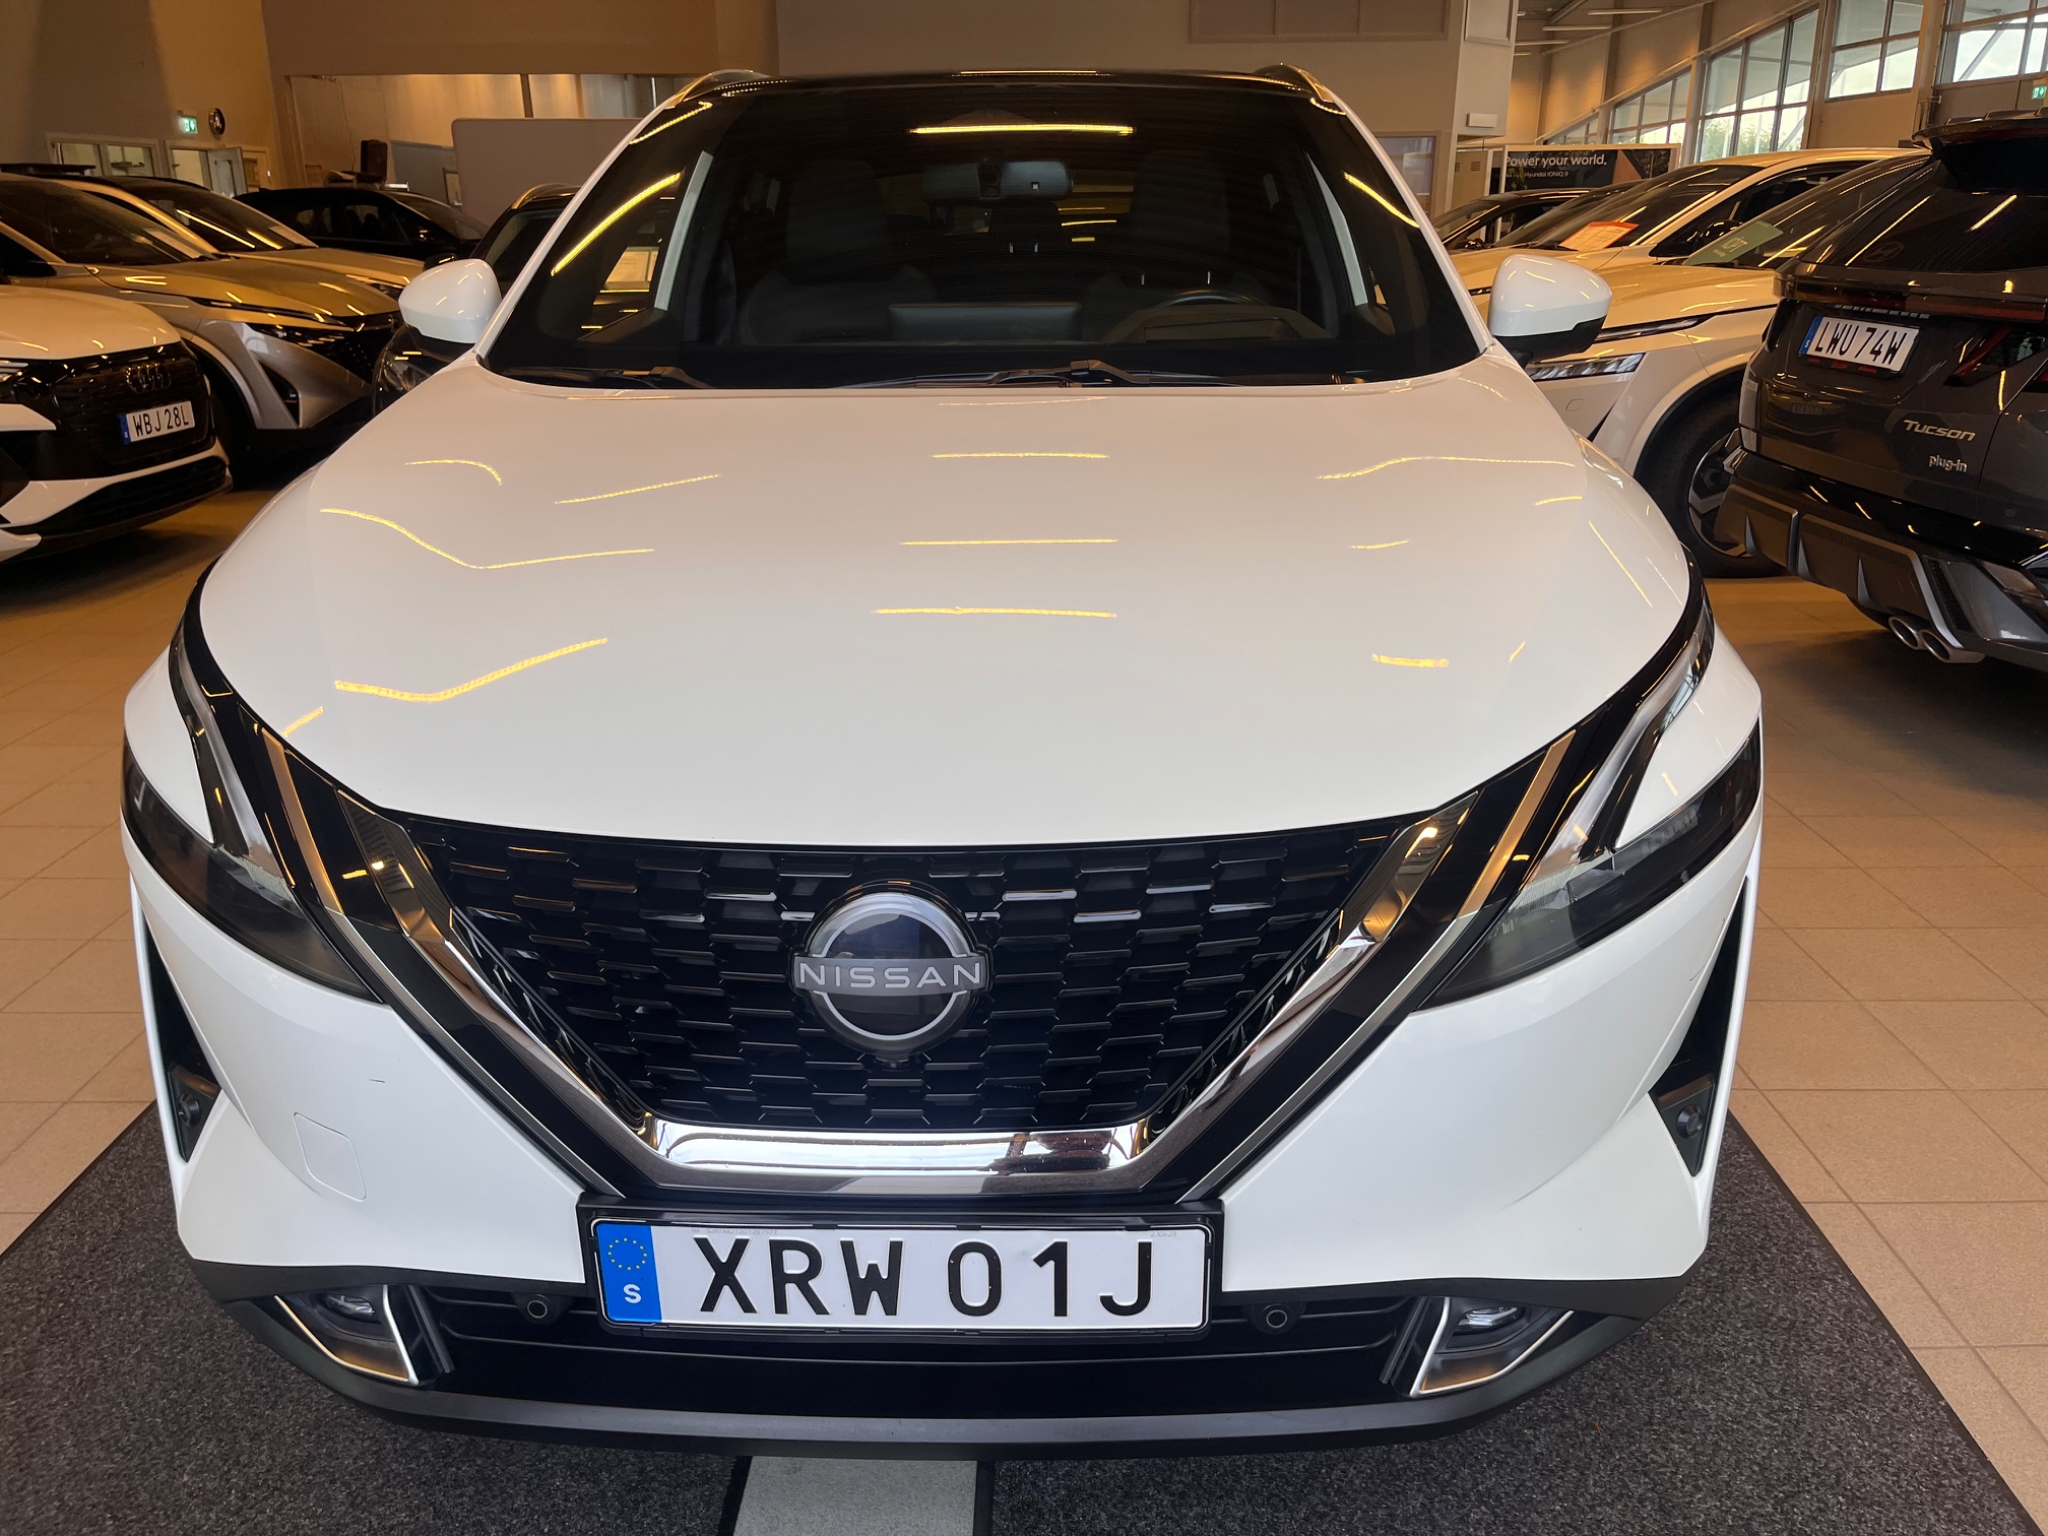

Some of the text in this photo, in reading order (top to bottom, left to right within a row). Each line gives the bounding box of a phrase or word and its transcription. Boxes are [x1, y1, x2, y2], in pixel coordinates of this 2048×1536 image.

[1542, 156, 1568, 168] your
[1571, 153, 1607, 166] world.
[1524, 171, 1546, 179] Hyundai
[1804, 340, 1810, 348] S
[1815, 321, 1859, 356] LWU
[1855, 326, 1908, 366] 74W
[132, 405, 189, 437] WBJ 28L
[1903, 419, 1976, 442] Tucson
[1928, 454, 1968, 473] plug-in
[800, 962, 980, 988] NISSAN
[693, 1237, 1152, 1317] XRW 01J
[623, 1284, 641, 1304] S
